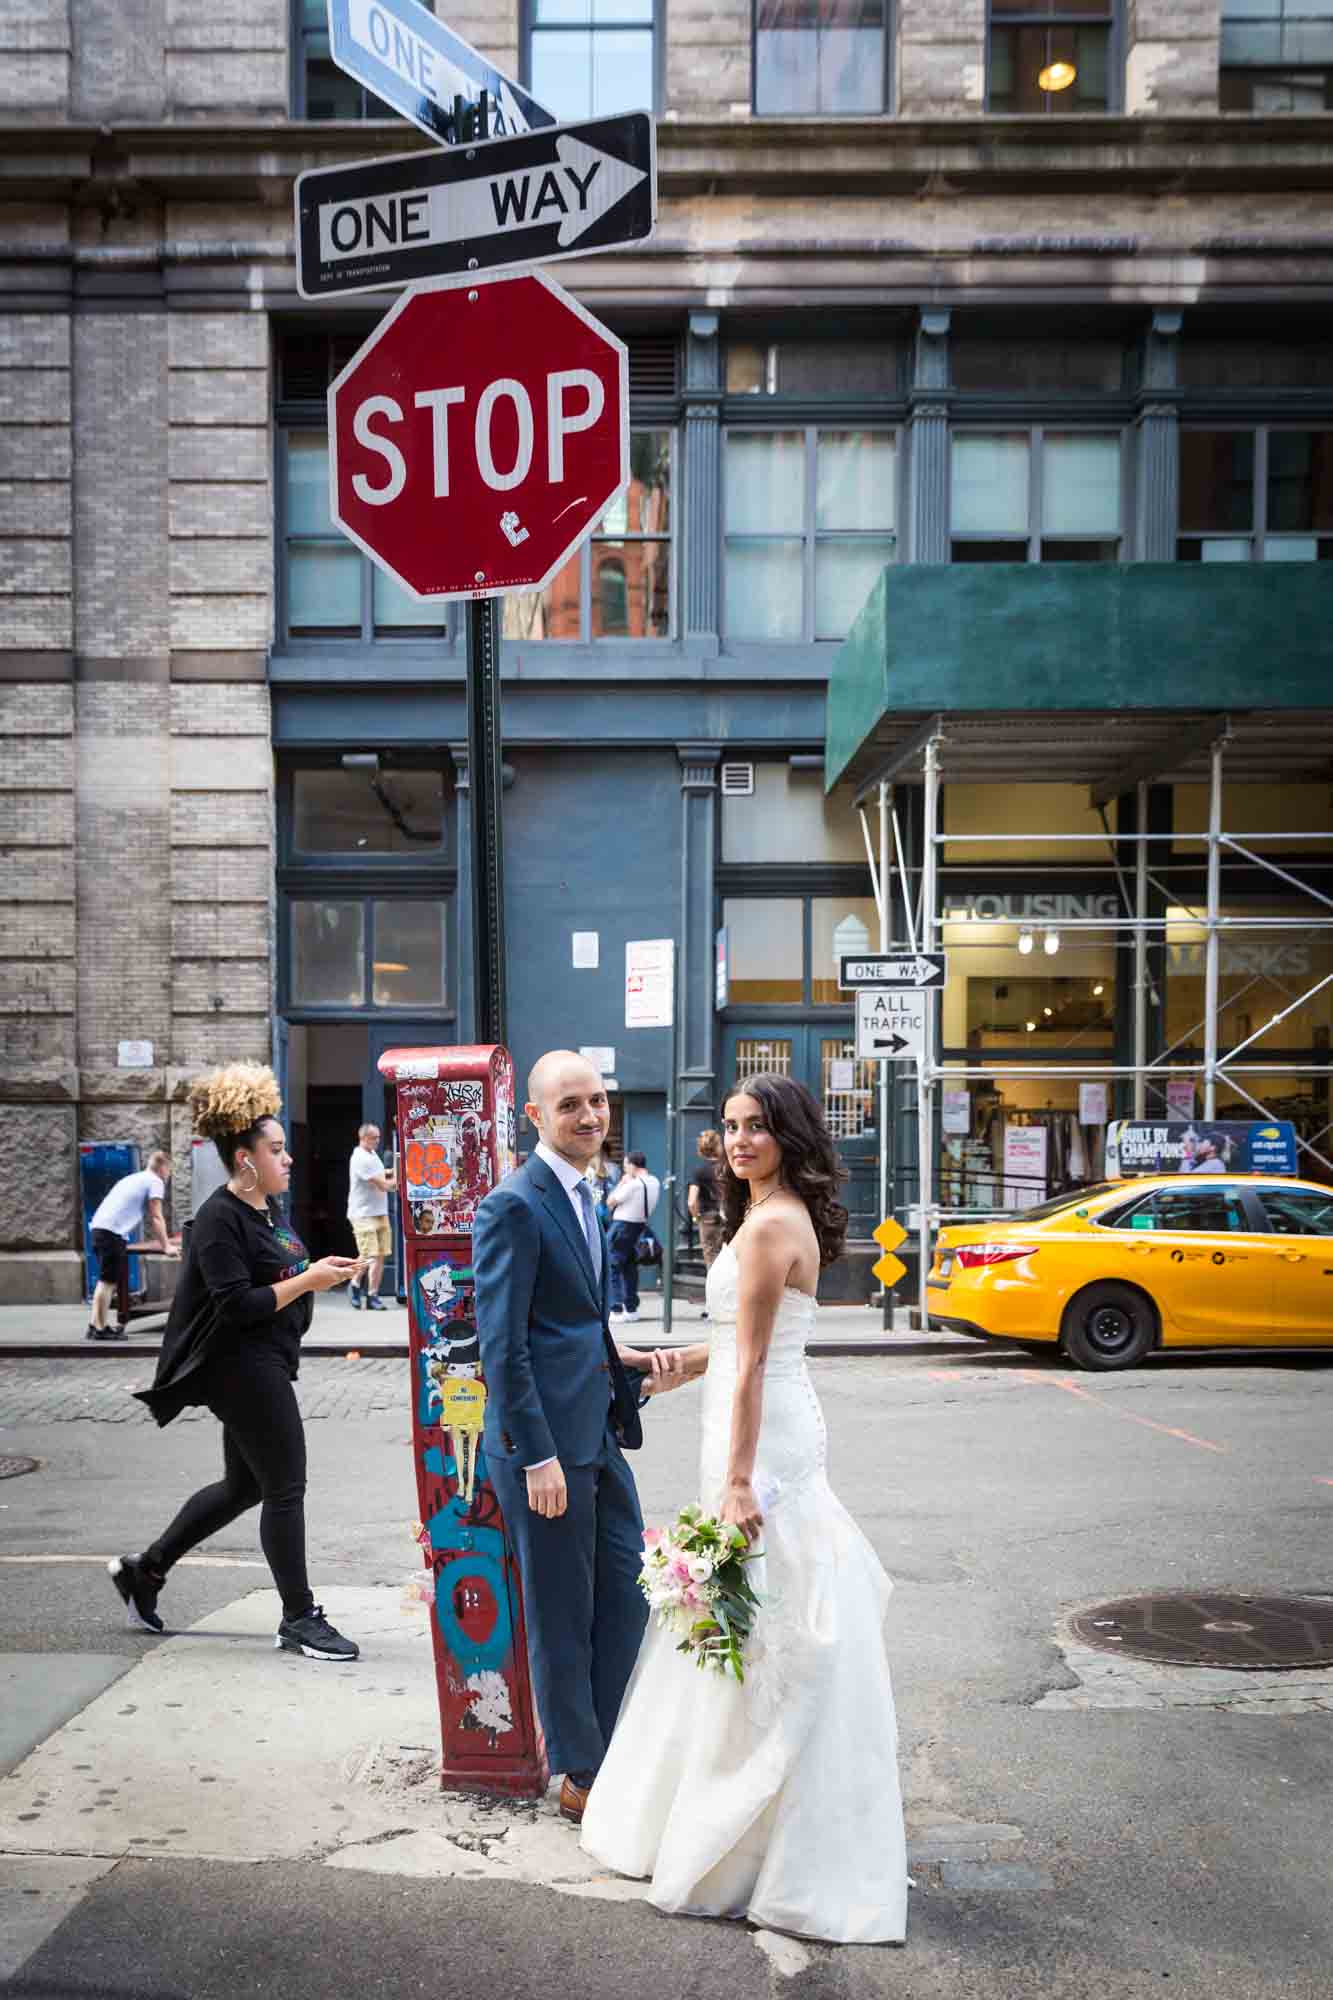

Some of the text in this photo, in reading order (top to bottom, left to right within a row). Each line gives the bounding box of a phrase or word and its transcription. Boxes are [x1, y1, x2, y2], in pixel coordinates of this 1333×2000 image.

[369, 7, 437, 90] ONE
[331, 161, 601, 253] ONE WAY
[352, 368, 605, 506] STOP
[944, 894, 1119, 919] HOUSING
[855, 965, 929, 978] ONE WAY
[874, 995, 911, 1012] ALL
[863, 1016, 922, 1030] TRAFFIC
[1153, 1127, 1169, 1143] BY
[1120, 1143, 1185, 1158] CHAMPIONS
